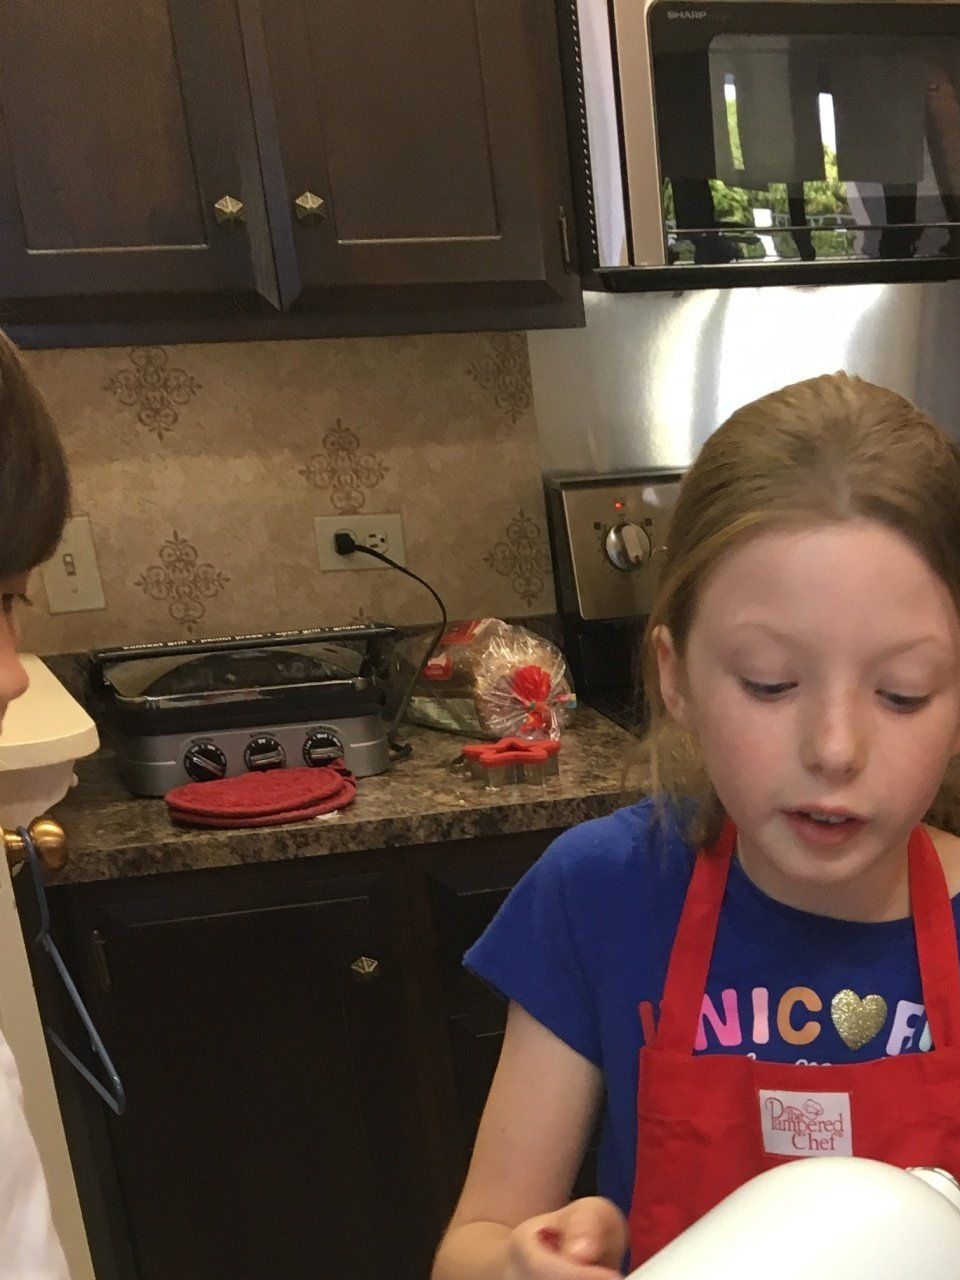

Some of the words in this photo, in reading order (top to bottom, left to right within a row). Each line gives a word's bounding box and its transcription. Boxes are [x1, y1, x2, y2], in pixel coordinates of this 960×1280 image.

[667, 10, 707, 19] SHARP
[765, 1097, 844, 1137] Pampered
[791, 1132, 837, 1151] Chef
